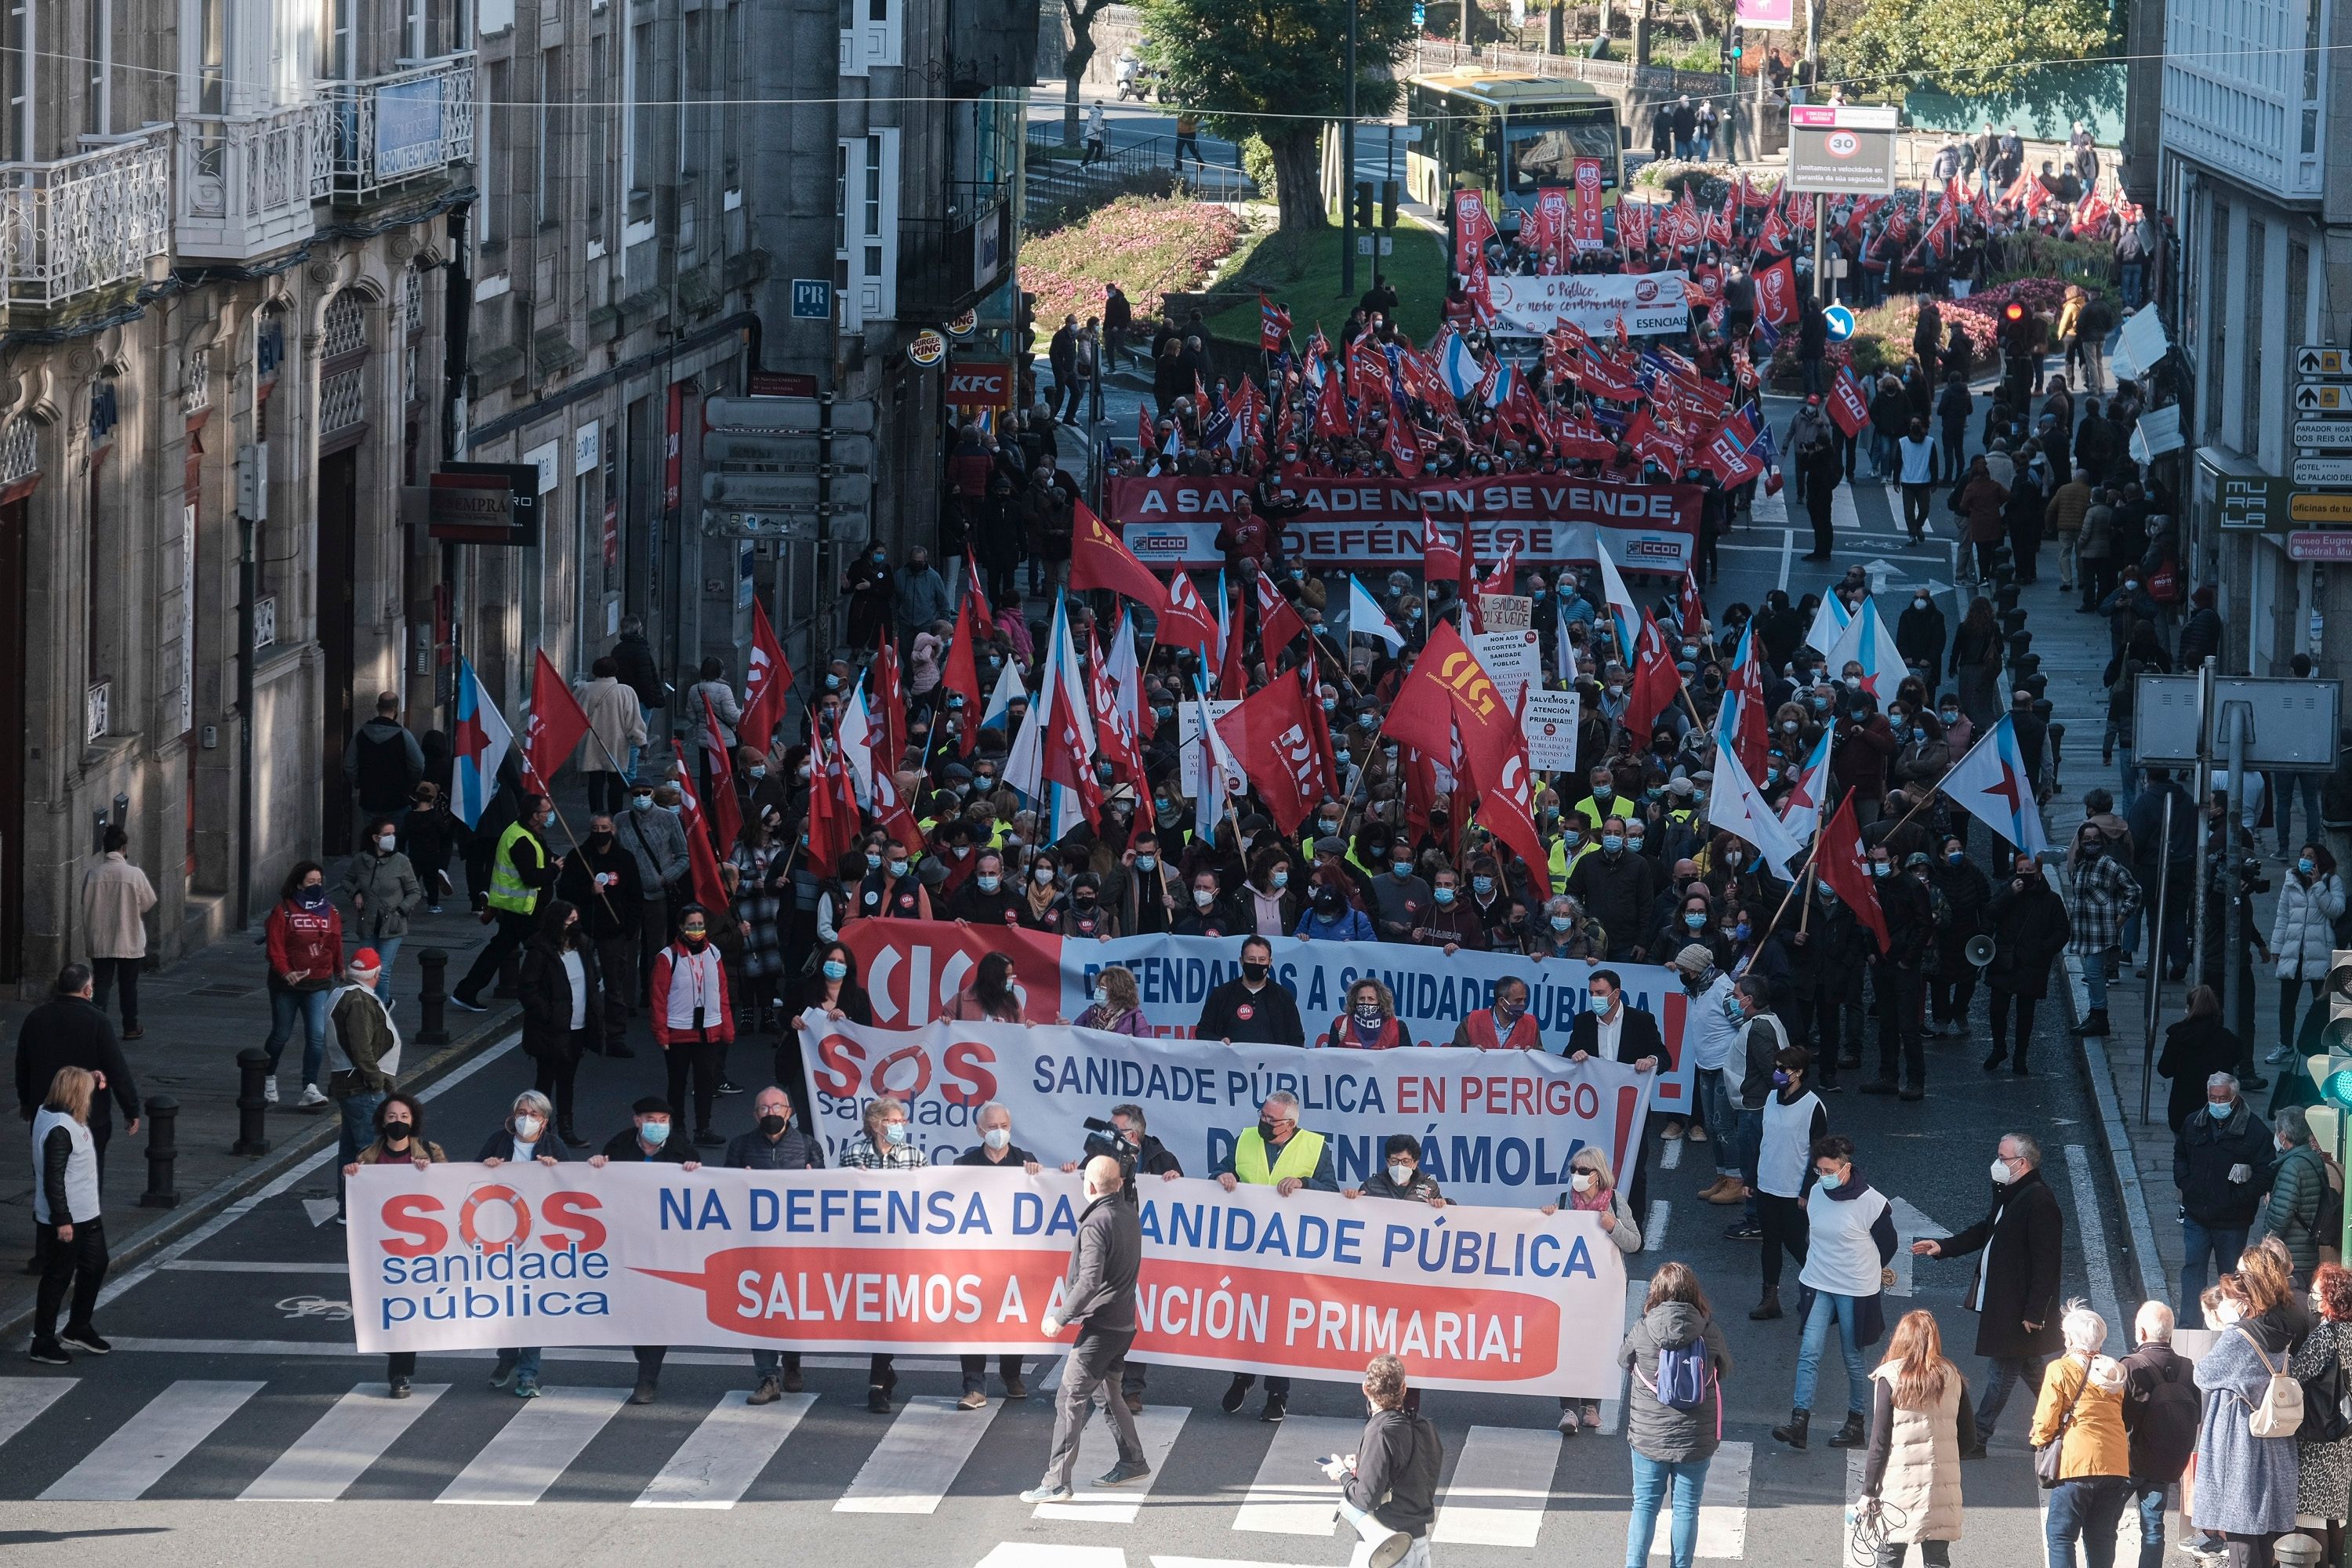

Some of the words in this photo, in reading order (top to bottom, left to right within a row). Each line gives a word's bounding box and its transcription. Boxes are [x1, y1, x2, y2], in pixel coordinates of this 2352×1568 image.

[1519, 107, 1535, 118] P2
[1833, 139, 1853, 148] 30
[379, 140, 439, 172] ARQUITECTURA
[1579, 167, 1596, 178] UGT
[1847, 175, 1886, 183] seguridade.
[1461, 199, 1478, 210] UGT
[798, 285, 824, 303] PR
[1637, 283, 1655, 295] UGT
[1636, 317, 1688, 328] ESENCIAIS
[912, 336, 940, 349] BURGER
[913, 343, 941, 357] KING
[949, 376, 1001, 392] KFC
[1712, 438, 1748, 474] CCOO
[513, 497, 532, 506] RO
[1140, 489, 1168, 514] A
[1177, 488, 1383, 514] SAADE
[1391, 488, 1475, 512] NON
[1484, 486, 1532, 511] SE
[1540, 487, 1682, 525] VENDE,
[1150, 539, 1185, 548] CCOO
[1643, 543, 1679, 554] CCOO
[1494, 611, 1502, 625] SE
[1483, 643, 1517, 652] RECORTES
[1442, 652, 1496, 717] CIG
[1530, 695, 1568, 705] SALVEMOS
[1533, 706, 1570, 715] ATENCIÓN
[1425, 927, 1461, 941] ULL&BEAR
[1084, 956, 1298, 1006] DENDAMS
[1307, 964, 1327, 1011] A
[1338, 967, 1495, 1024] SNIDADE
[1354, 1014, 1381, 1029] CCOO
[1033, 1054, 1217, 1105] SANIDADE
[1229, 1062, 1383, 1115] PÚBLICA
[1398, 1076, 1446, 1114] EN
[1461, 1076, 1599, 1120] PERIGO
[816, 1090, 985, 1127] sadad
[1207, 1123, 1589, 1189] DENÁMOLA
[379, 1184, 607, 1256] SOS
[660, 1188, 731, 1231] NA
[750, 1189, 993, 1236] DEFENSA
[1012, 1191, 1078, 1237] DA
[1138, 1200, 1363, 1265] ANIDADE
[1384, 1215, 1596, 1279] PÚBLICA
[382, 1242, 610, 1285] sanidade
[382, 1286, 610, 1330] pública
[737, 1270, 982, 1323] SALVEMOS
[996, 1288, 1028, 1324] A
[1040, 1275, 1269, 1345] ANCIÓN
[1285, 1297, 1523, 1363] PRIMARIA!
